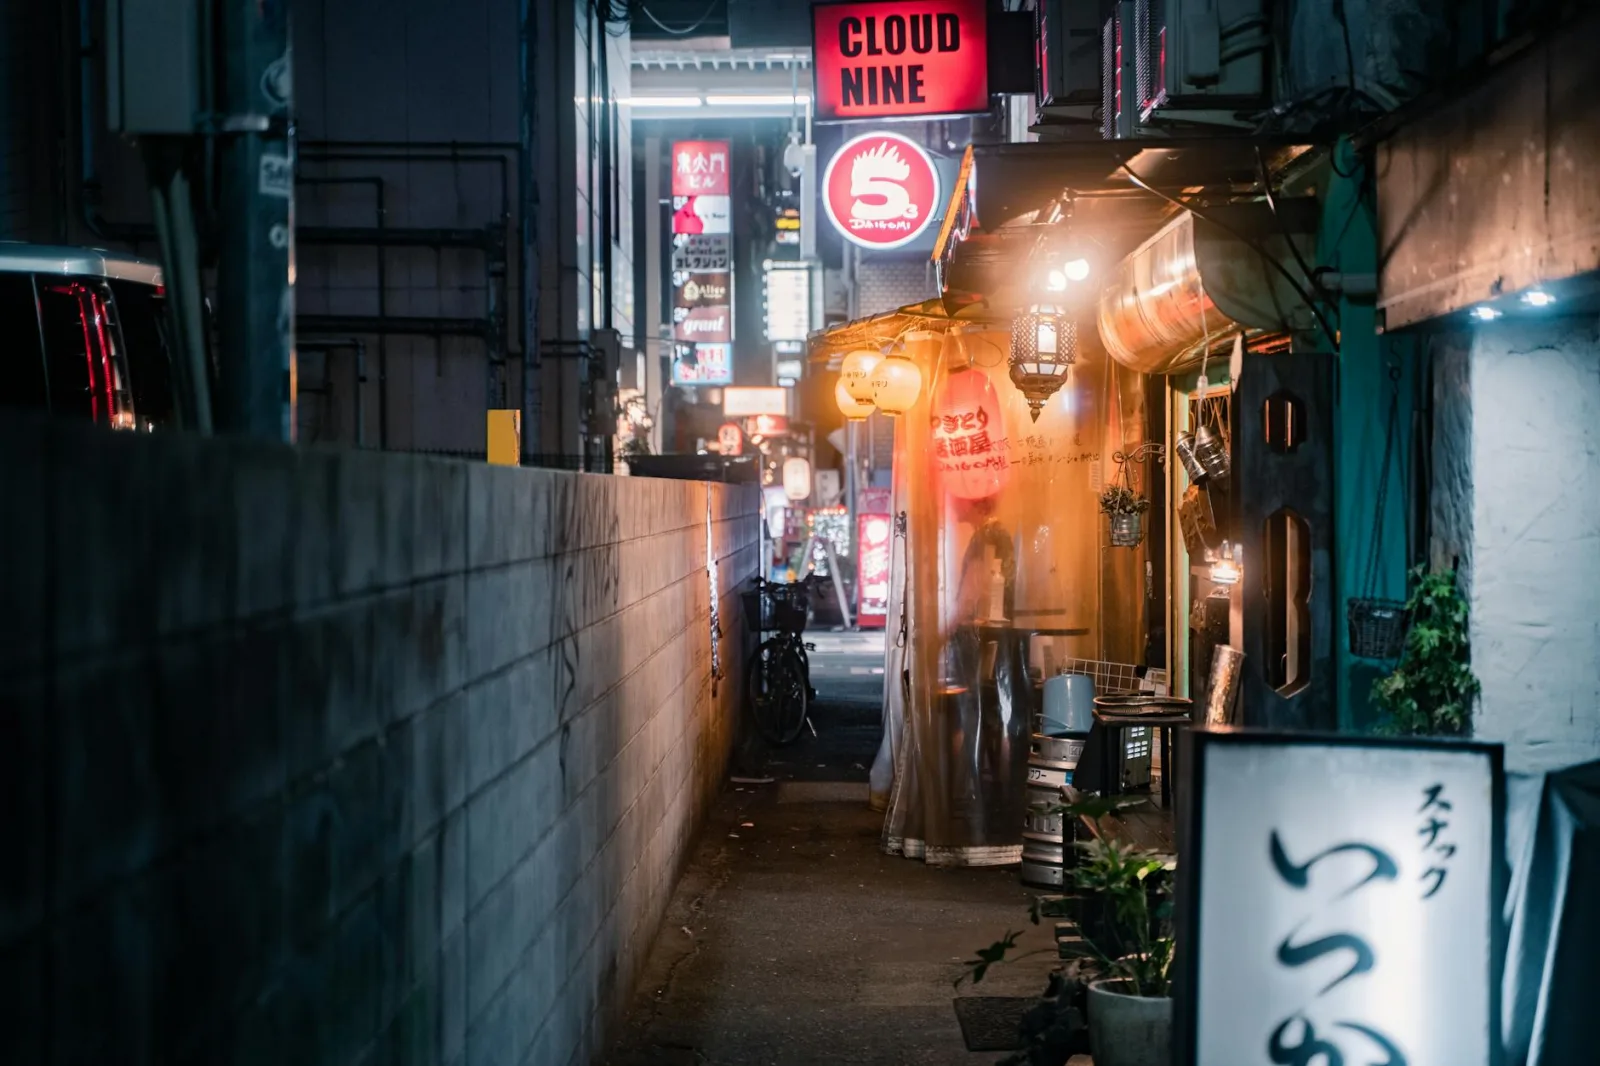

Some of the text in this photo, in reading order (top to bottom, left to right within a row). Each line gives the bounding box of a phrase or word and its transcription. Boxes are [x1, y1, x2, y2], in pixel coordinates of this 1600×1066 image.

[839, 13, 960, 57] CLOUD
[841, 64, 925, 106] NINE
[677, 151, 725, 173] 東大門
[675, 258, 727, 269] コレクション
[683, 316, 725, 335] grant
[1418, 783, 1457, 900] スナック
